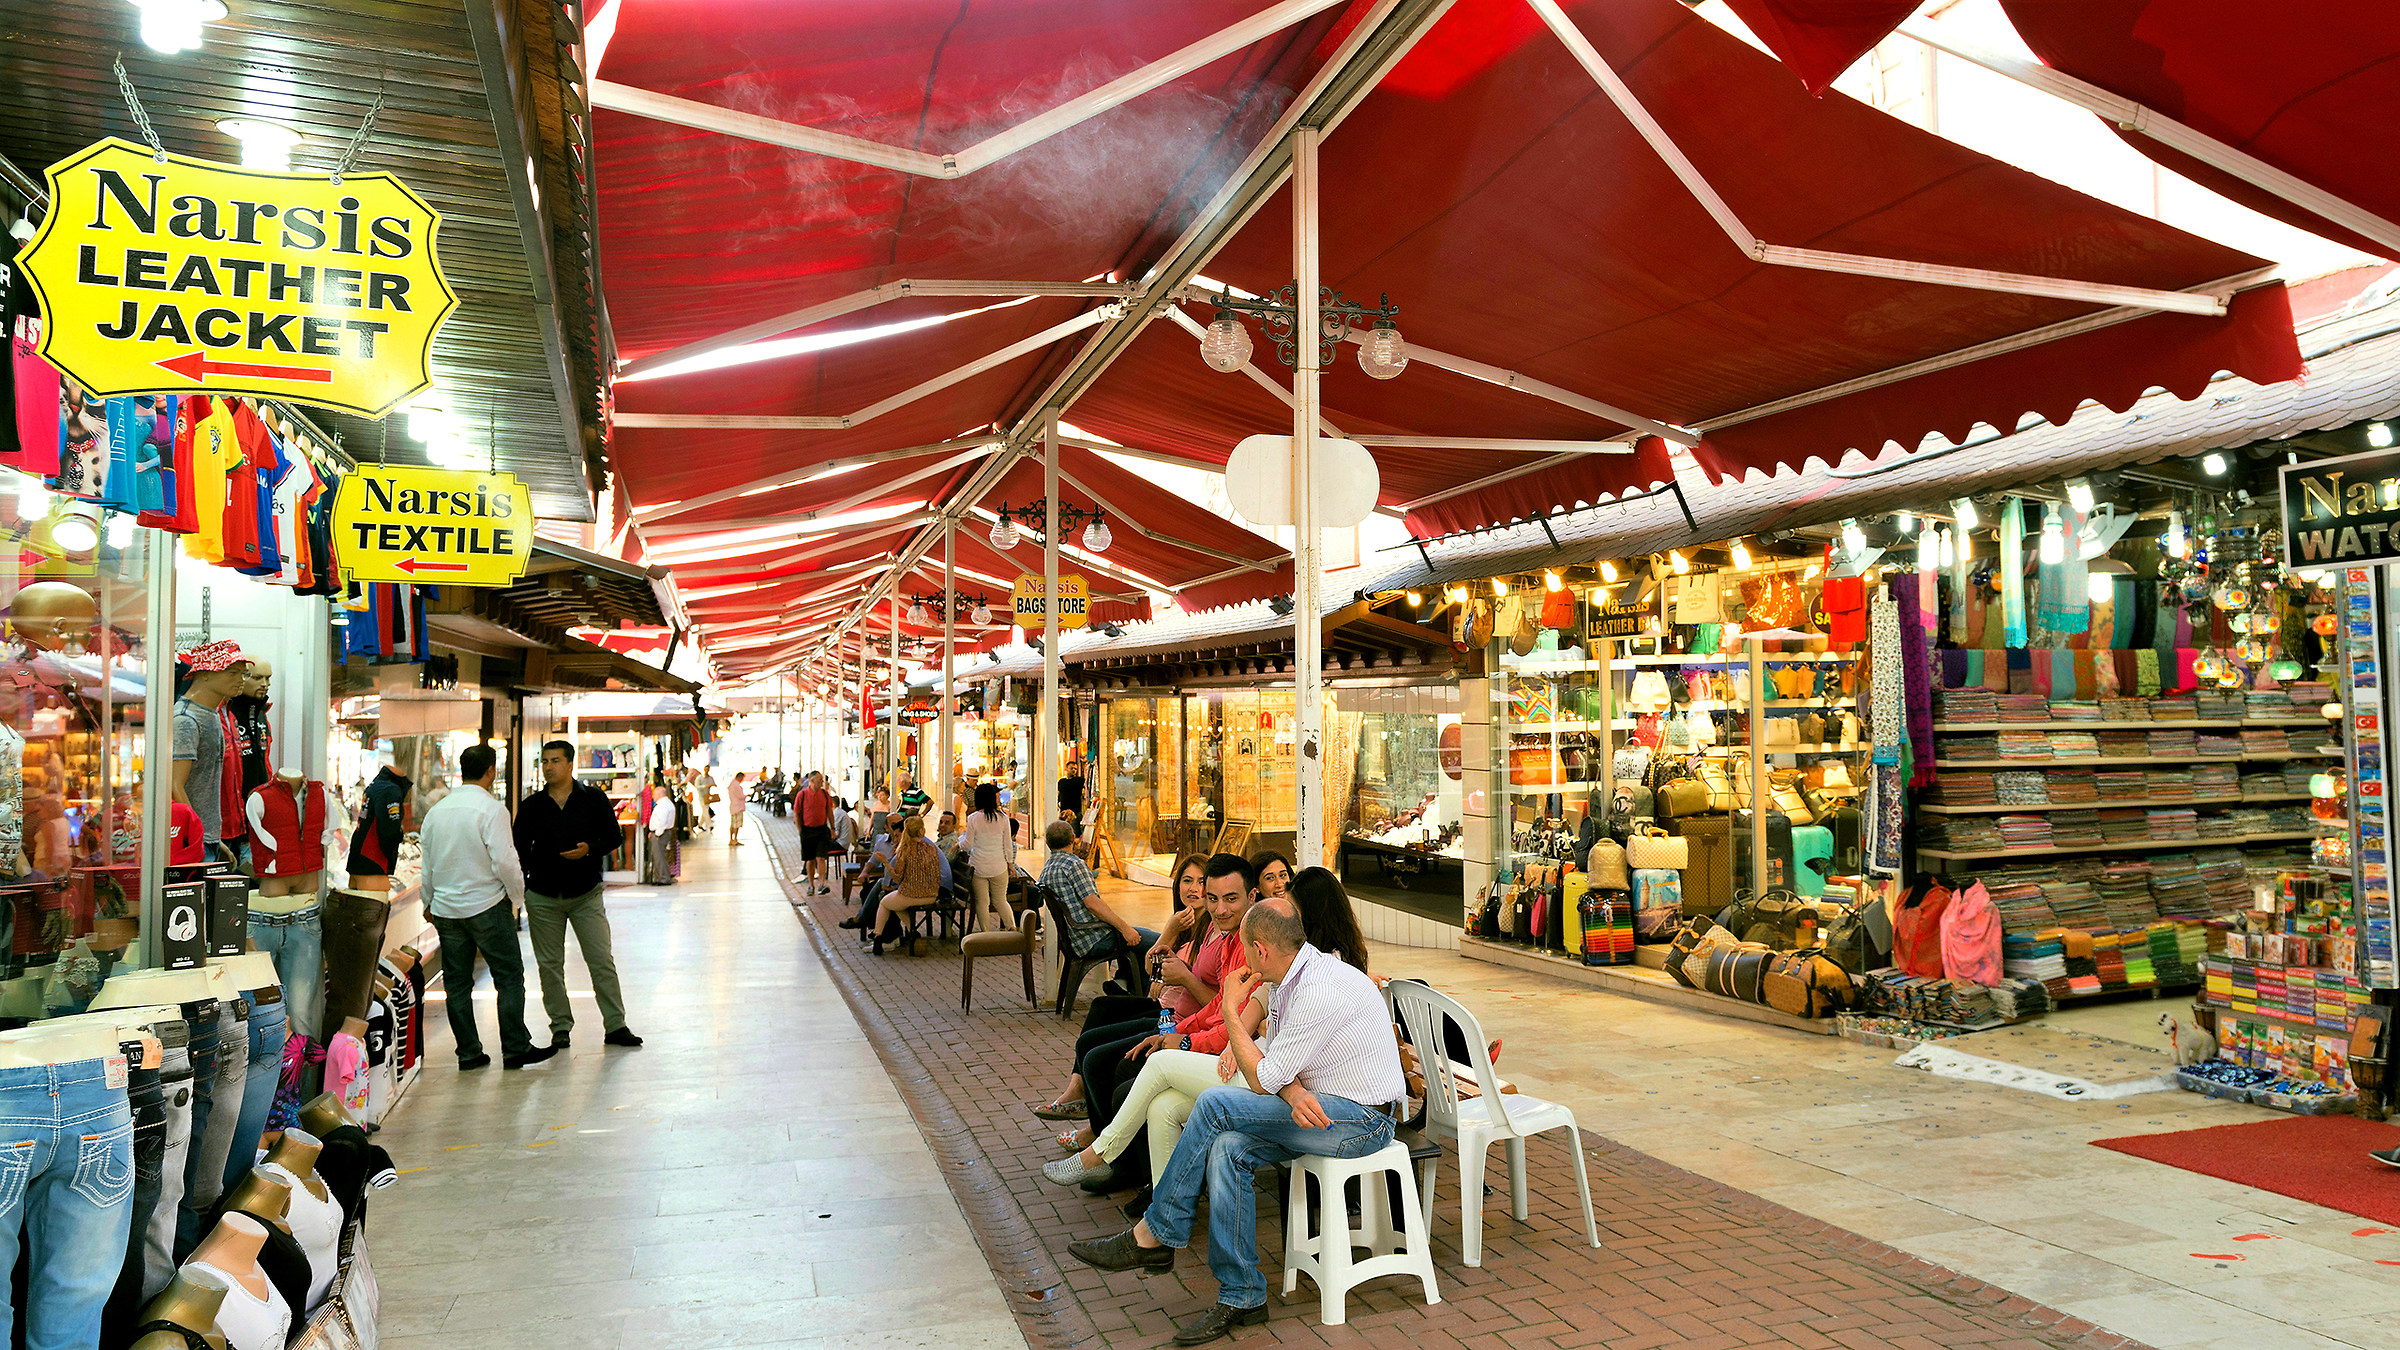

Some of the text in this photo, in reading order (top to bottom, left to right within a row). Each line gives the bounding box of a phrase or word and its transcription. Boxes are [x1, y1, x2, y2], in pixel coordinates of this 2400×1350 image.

[87, 168, 413, 258] Narsis
[77, 245, 414, 313] LEATHER
[95, 301, 390, 360] JACKET
[361, 477, 513, 518] Narsis
[352, 523, 514, 556] TEXTILE
[1024, 579, 1079, 594] Nasis
[1590, 614, 1659, 636] LEATHER BAG
